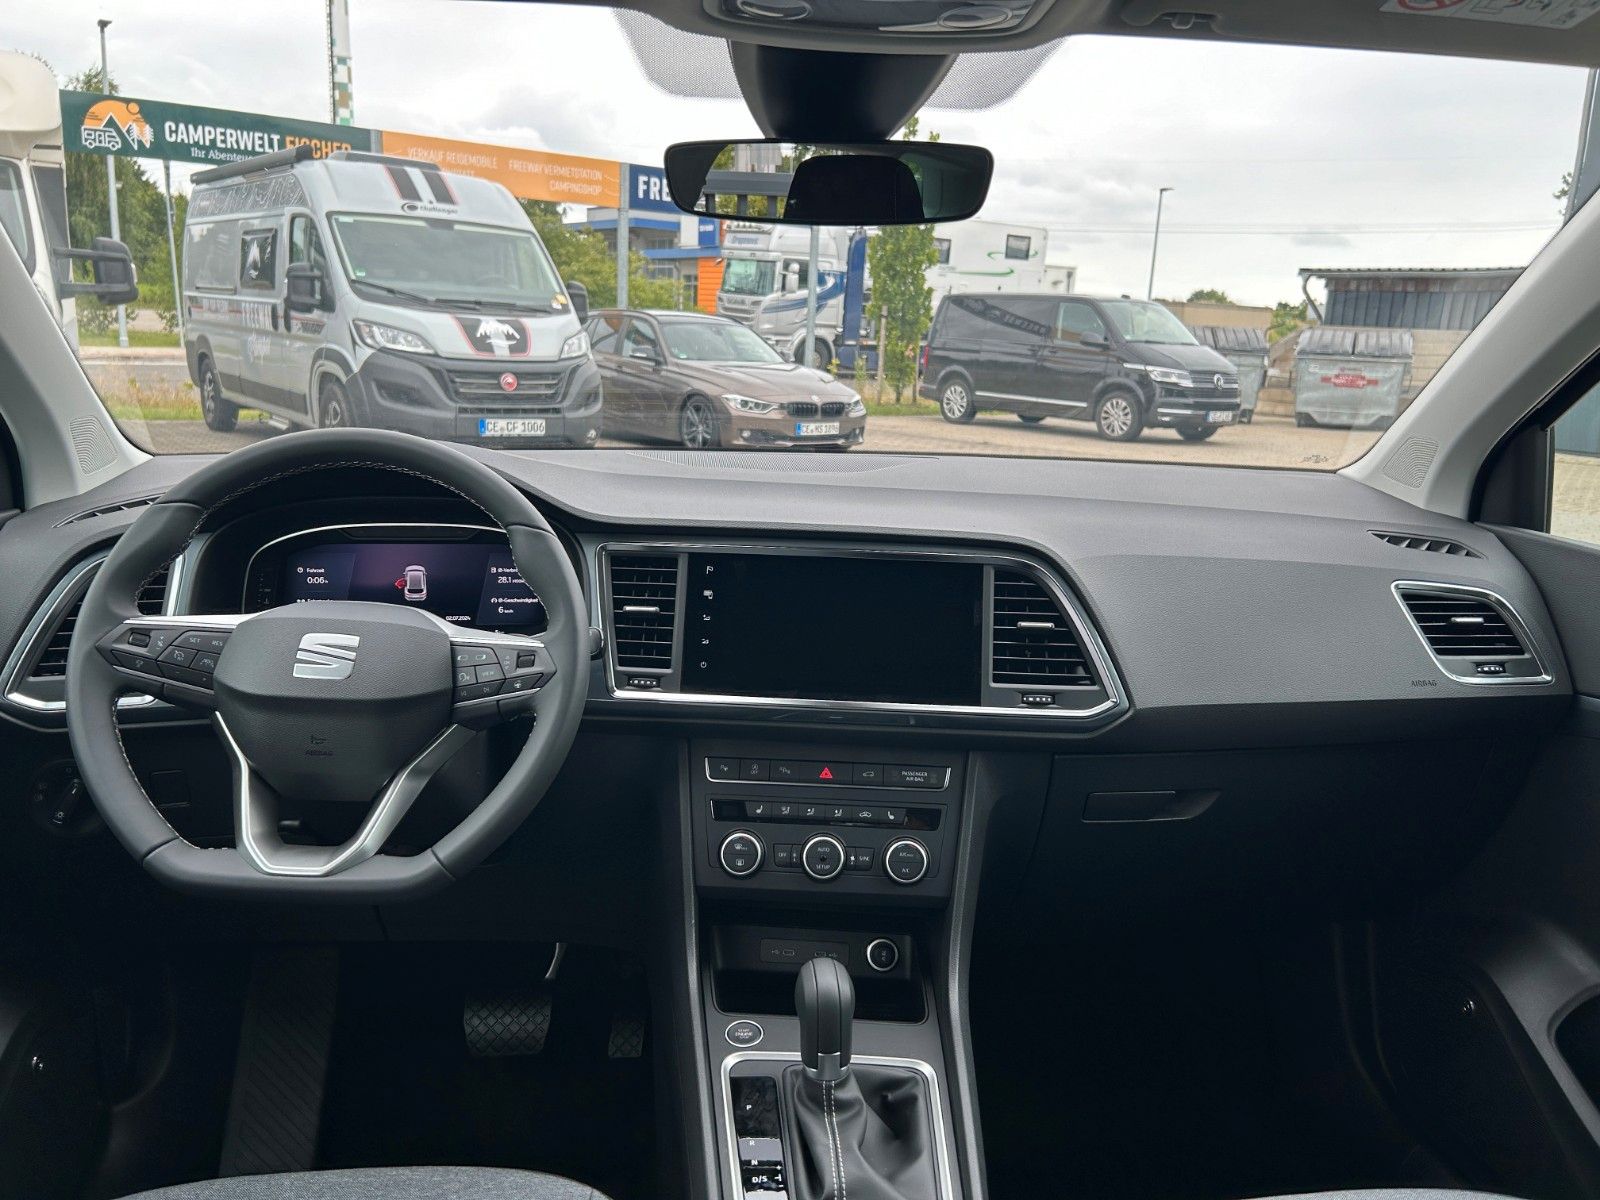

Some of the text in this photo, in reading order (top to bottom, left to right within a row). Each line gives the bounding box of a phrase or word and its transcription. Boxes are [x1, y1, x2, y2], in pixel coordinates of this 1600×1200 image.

[164, 120, 280, 153] CAMPERWELT
[191, 147, 206, 158] Ihr
[508, 159, 543, 175] FREEWAY
[751, 1175, 768, 1183] D/S
